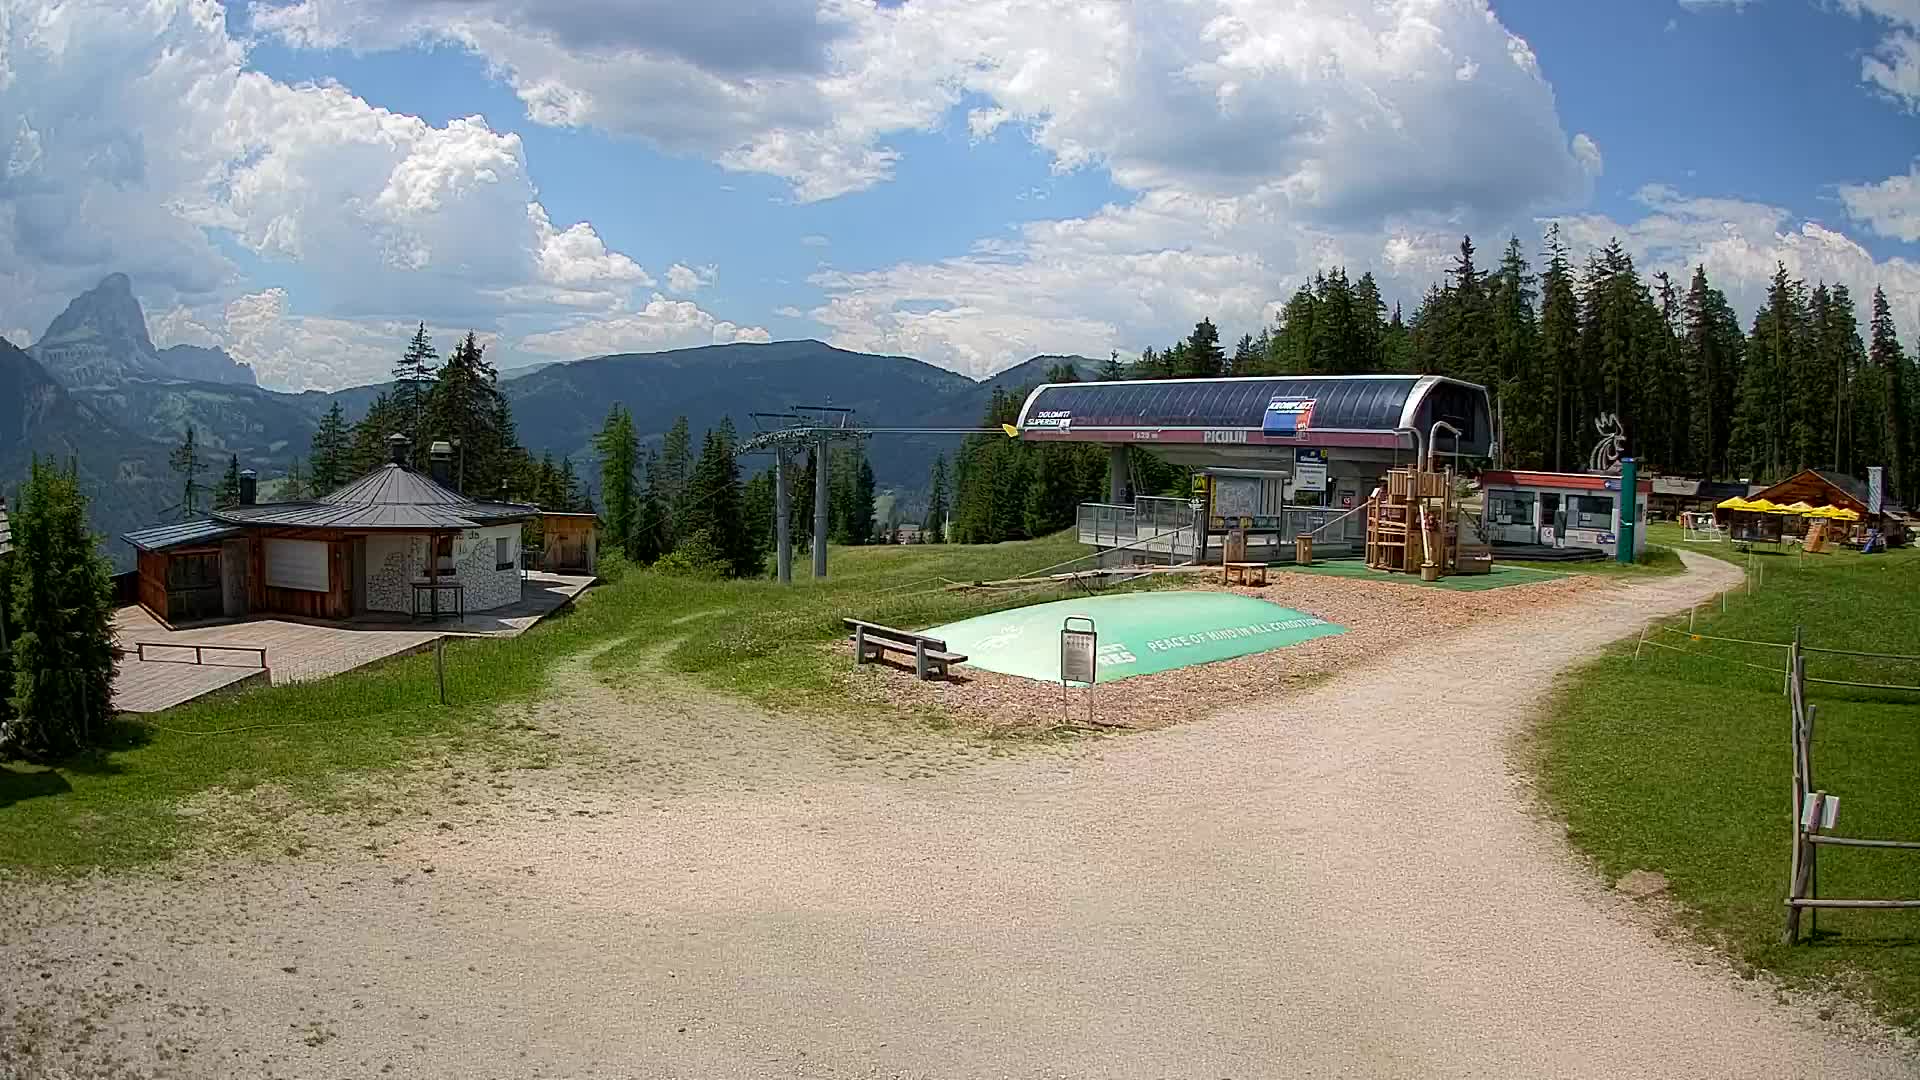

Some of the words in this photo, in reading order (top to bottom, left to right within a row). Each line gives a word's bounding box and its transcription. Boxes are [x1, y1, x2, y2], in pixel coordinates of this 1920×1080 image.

[1037, 410, 1071, 418] DOLOMITI
[1203, 430, 1247, 443] PICULIN
[1146, 635, 1191, 653] PEACE
[1189, 632, 1207, 645] OF
[1207, 628, 1238, 642] MIND
[1237, 626, 1251, 637] IN
[1250, 623, 1271, 635] ALL
